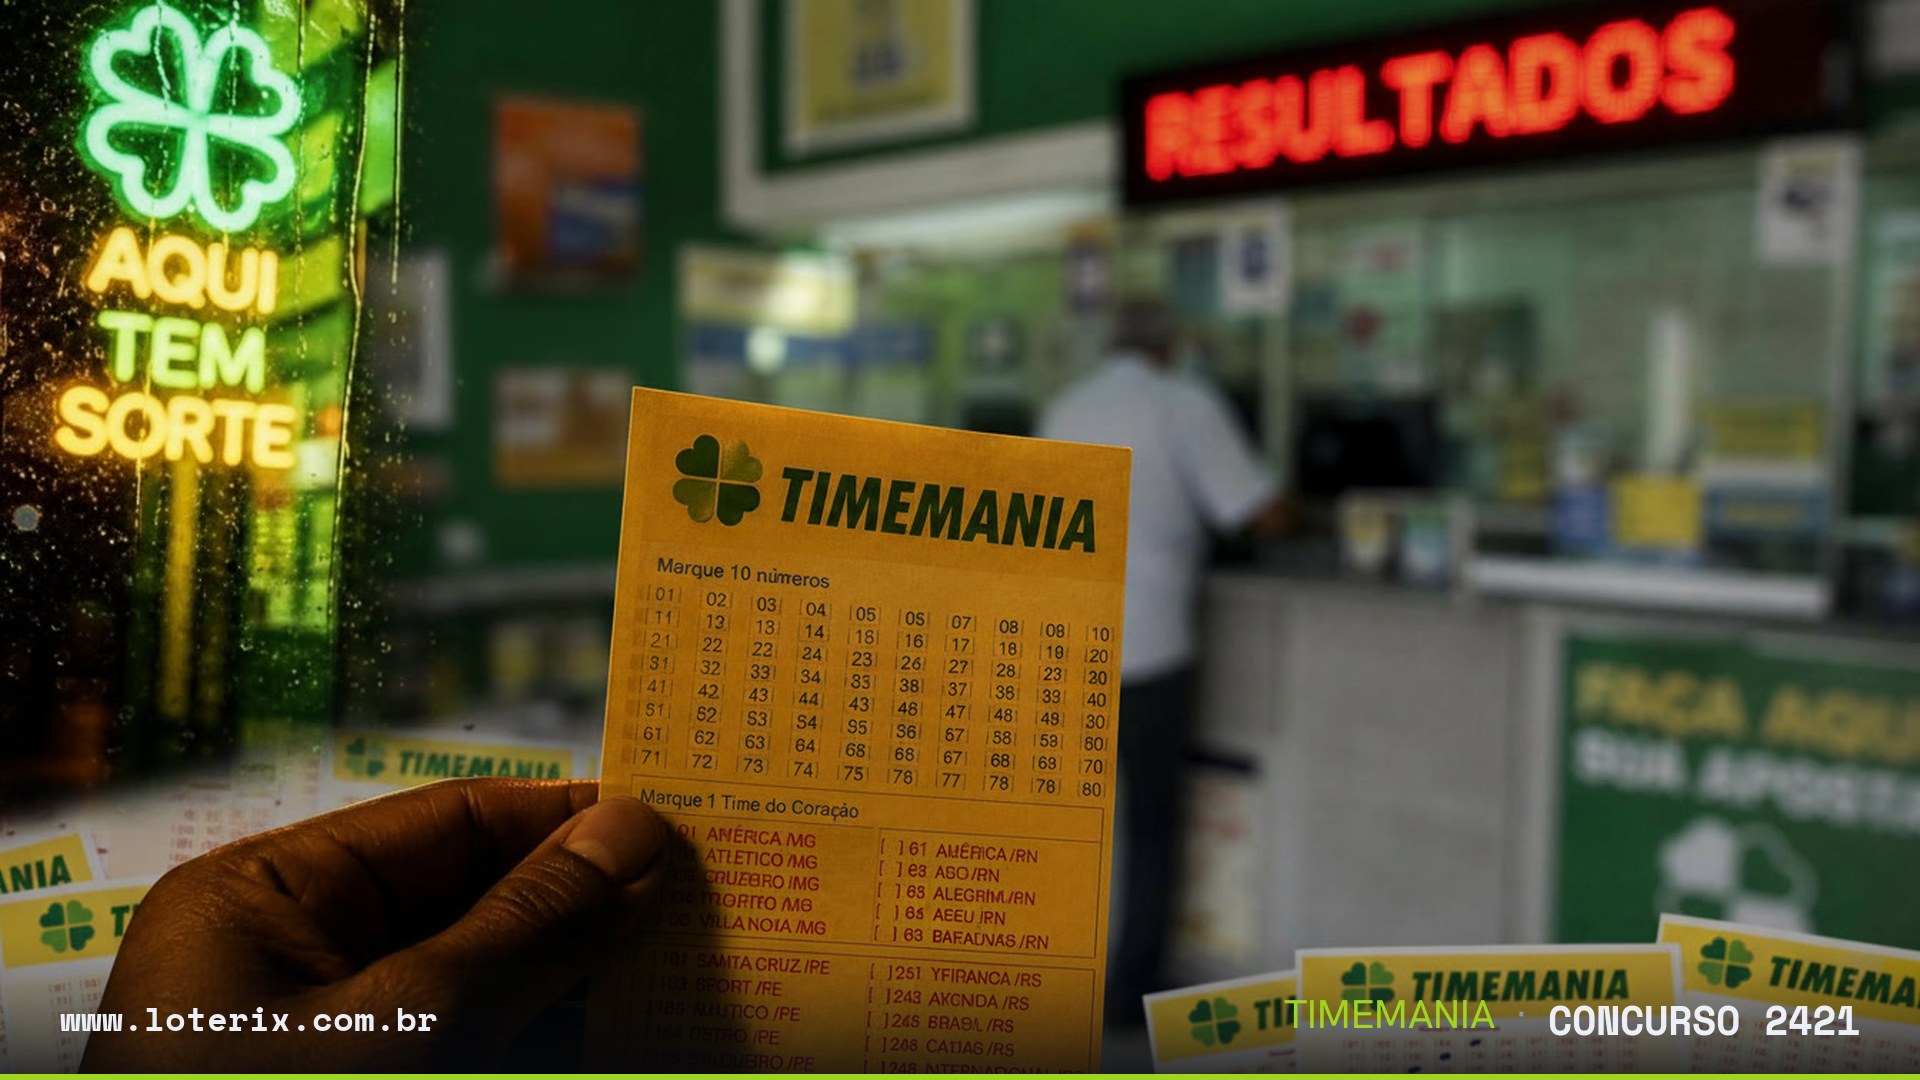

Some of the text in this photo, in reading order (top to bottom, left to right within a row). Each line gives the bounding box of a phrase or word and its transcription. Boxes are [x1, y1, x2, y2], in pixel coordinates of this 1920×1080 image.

[1144, 7, 1735, 184] RESULTADOS
[87, 226, 279, 315] AQUI
[97, 310, 267, 394] TEM
[54, 385, 296, 469] SORTE
[780, 466, 1097, 553] TIMEMANIA
[656, 556, 725, 581] Marque
[731, 562, 751, 581] 10
[655, 586, 674, 602] 01
[706, 592, 727, 608] 02
[757, 597, 777, 613] 03
[806, 602, 826, 617] 04
[856, 607, 876, 622] 05
[951, 615, 972, 630] 07
[999, 620, 1019, 634] 08
[1046, 624, 1065, 638] 08
[1092, 627, 1110, 642] 10
[650, 633, 671, 649] 21
[702, 637, 723, 653] 22
[802, 647, 822, 662] 24
[901, 656, 922, 671] 26
[948, 659, 969, 675] 27
[996, 664, 1016, 678] 28
[1044, 667, 1062, 681] 23
[805, 624, 825, 639] 14
[906, 633, 924, 649] 16
[952, 638, 970, 653] 17
[1089, 649, 1109, 664] 20
[647, 679, 666, 694] 41
[698, 684, 720, 700] 42
[748, 687, 769, 703] 43
[799, 692, 819, 706] 44
[849, 697, 870, 712] 43
[946, 705, 966, 719] 47
[994, 708, 1013, 723] 48
[700, 660, 721, 676] 32
[751, 664, 771, 680] 33
[801, 669, 821, 684] 34
[900, 679, 920, 693] 38
[948, 683, 968, 697] 37
[1087, 693, 1107, 708] 40
[643, 726, 661, 741] 61
[694, 730, 716, 746] 62
[745, 735, 766, 750] 63
[795, 738, 815, 753] 64
[943, 751, 963, 765] 67
[1084, 760, 1103, 774] 70
[641, 749, 660, 765] 71
[692, 754, 713, 770] 72
[743, 758, 764, 774] 73
[793, 762, 813, 777] 74
[844, 766, 864, 781] 75
[942, 773, 961, 788] 77
[989, 776, 1009, 790] 78
[1083, 783, 1101, 797] 80
[640, 788, 703, 809] Marque
[707, 793, 716, 808] 1
[721, 794, 761, 812] Time
[765, 798, 786, 814] do
[785, 832, 817, 849] /MG
[908, 841, 927, 857] 61
[1009, 847, 1039, 864] /RN
[786, 853, 819, 870] /MG
[971, 867, 1000, 884] /RN
[788, 874, 821, 892] /MG
[1018, 934, 1050, 950] /RN
[755, 956, 802, 974] CRUZ
[1013, 971, 1043, 989] /RS
[1412, 968, 1630, 1002] TIMEMANIA
[1769, 955, 1920, 1010] TIMEMA
[1001, 995, 1031, 1012] /RS
[986, 1017, 1015, 1034] /RS
[986, 1041, 1016, 1058] /RS
